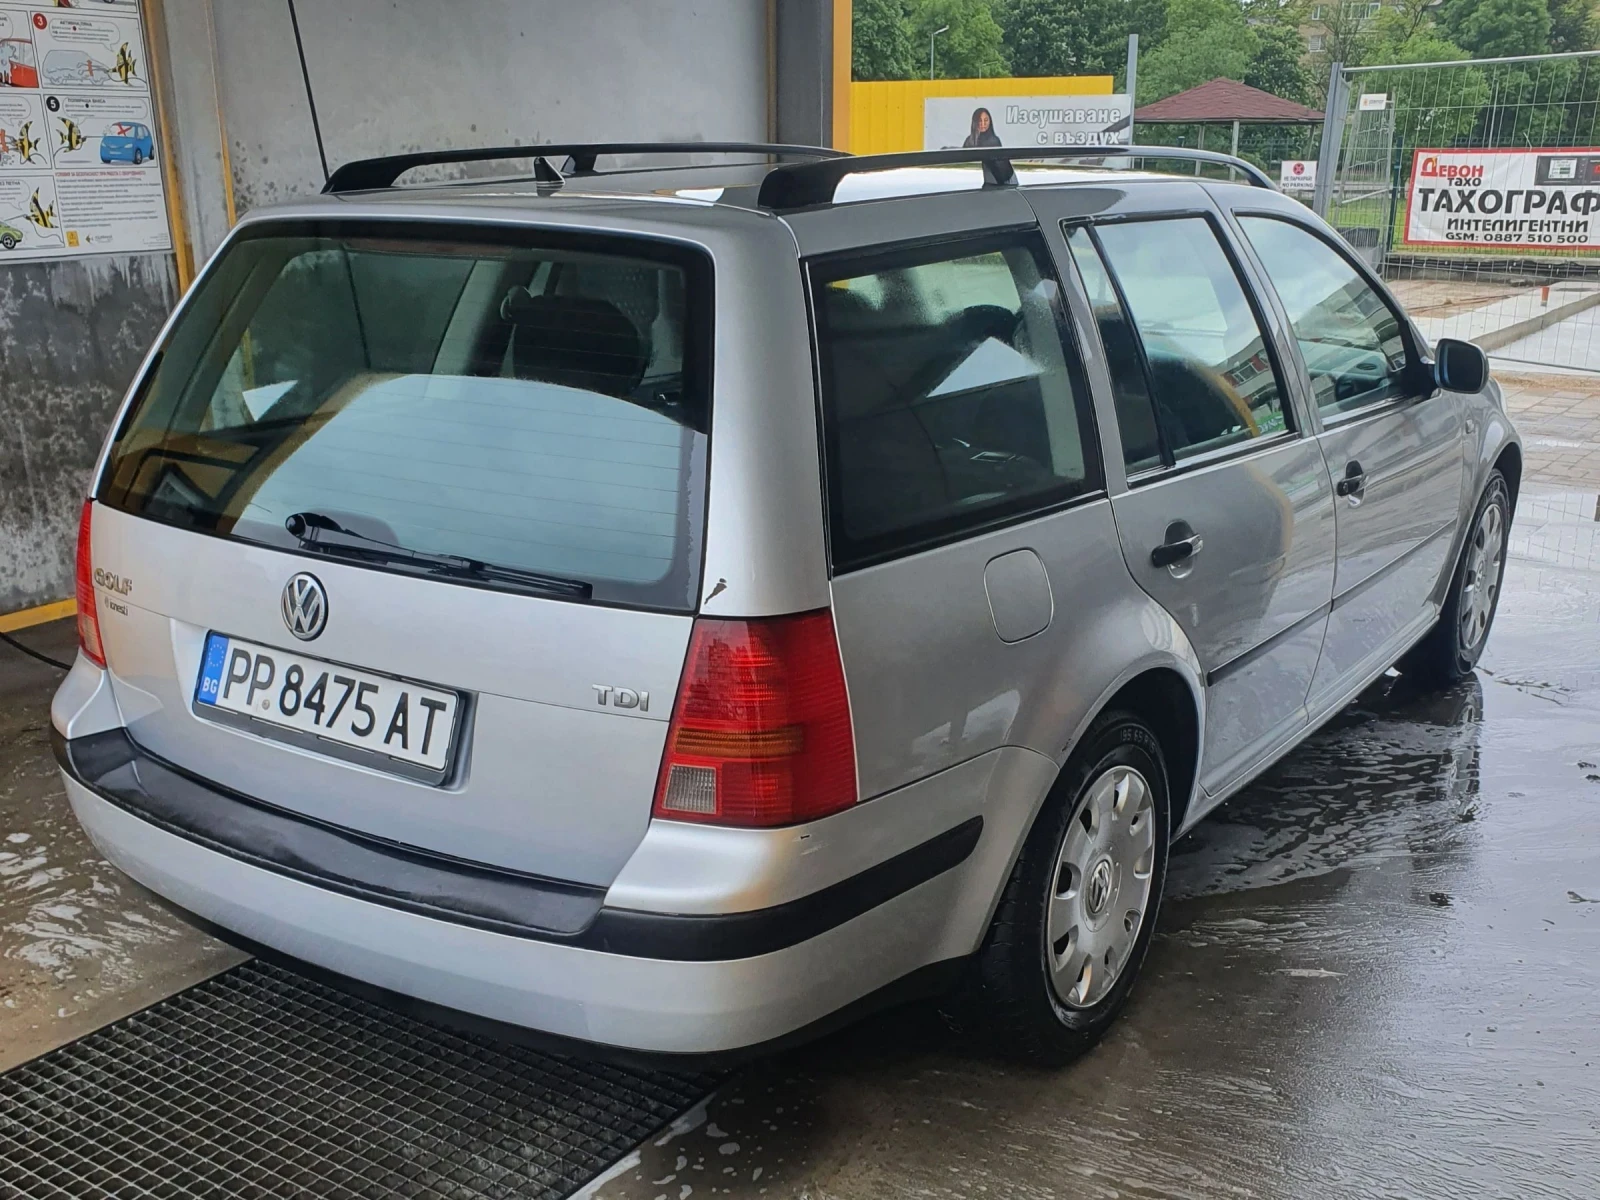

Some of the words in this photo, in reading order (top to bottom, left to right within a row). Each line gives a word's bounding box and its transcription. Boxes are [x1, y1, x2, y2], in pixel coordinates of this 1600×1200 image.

[37, 16, 44, 26] 3
[50, 99, 57, 109] 5
[1005, 105, 1121, 129] Изсушаване
[1037, 131, 1048, 145] с
[1053, 131, 1120, 146] въздух
[1420, 157, 1484, 178] ДЕВОН
[1447, 177, 1482, 187] тахо
[1418, 188, 1600, 216] ТАХОГРАФ
[1447, 218, 1588, 233] ИНТЕЛИГЕНТНИ
[1445, 232, 1479, 241] GSM:
[1484, 233, 1522, 242] 0887
[1527, 233, 1552, 243] 510
[1557, 234, 1588, 243] 500
[94, 568, 132, 596] GOLF
[202, 676, 218, 694] BG
[591, 684, 649, 712] TDI
[279, 664, 379, 737] 8475
[383, 691, 447, 755] AT
